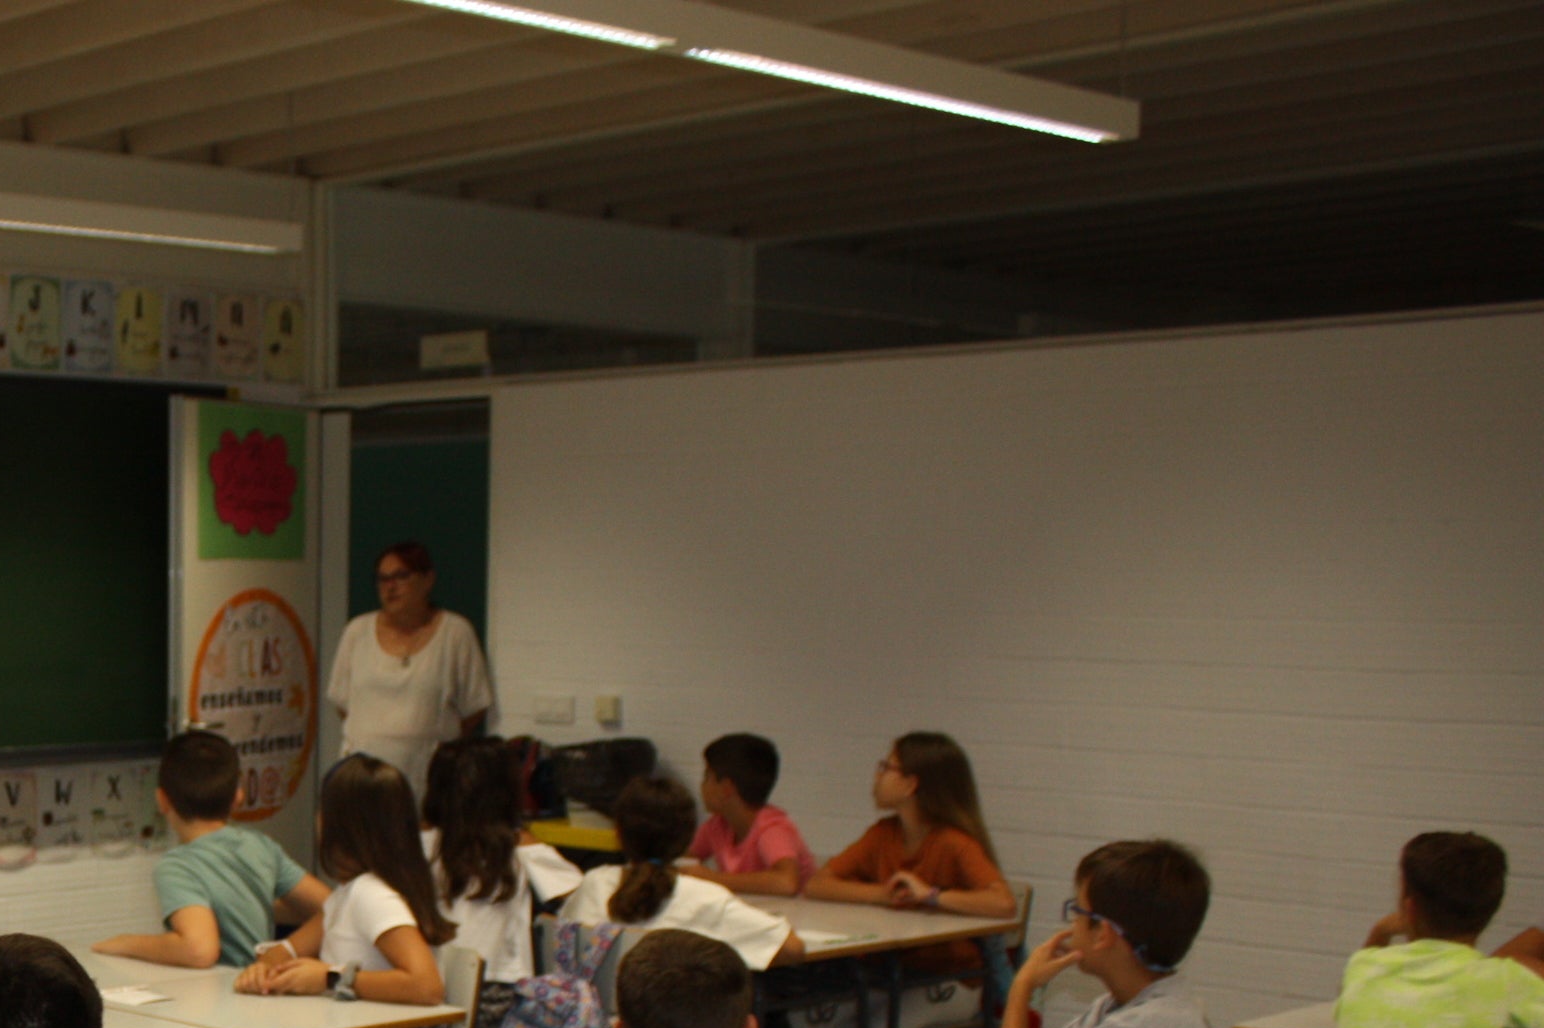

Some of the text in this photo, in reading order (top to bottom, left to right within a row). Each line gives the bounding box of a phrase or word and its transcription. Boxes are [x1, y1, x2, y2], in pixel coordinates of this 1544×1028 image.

[29, 284, 41, 312] J
[80, 289, 96, 317] K
[201, 685, 283, 711] enseñamos
[235, 733, 304, 755] rendemos
[3, 780, 20, 807] V
[55, 779, 73, 805] W
[107, 775, 122, 801] X
